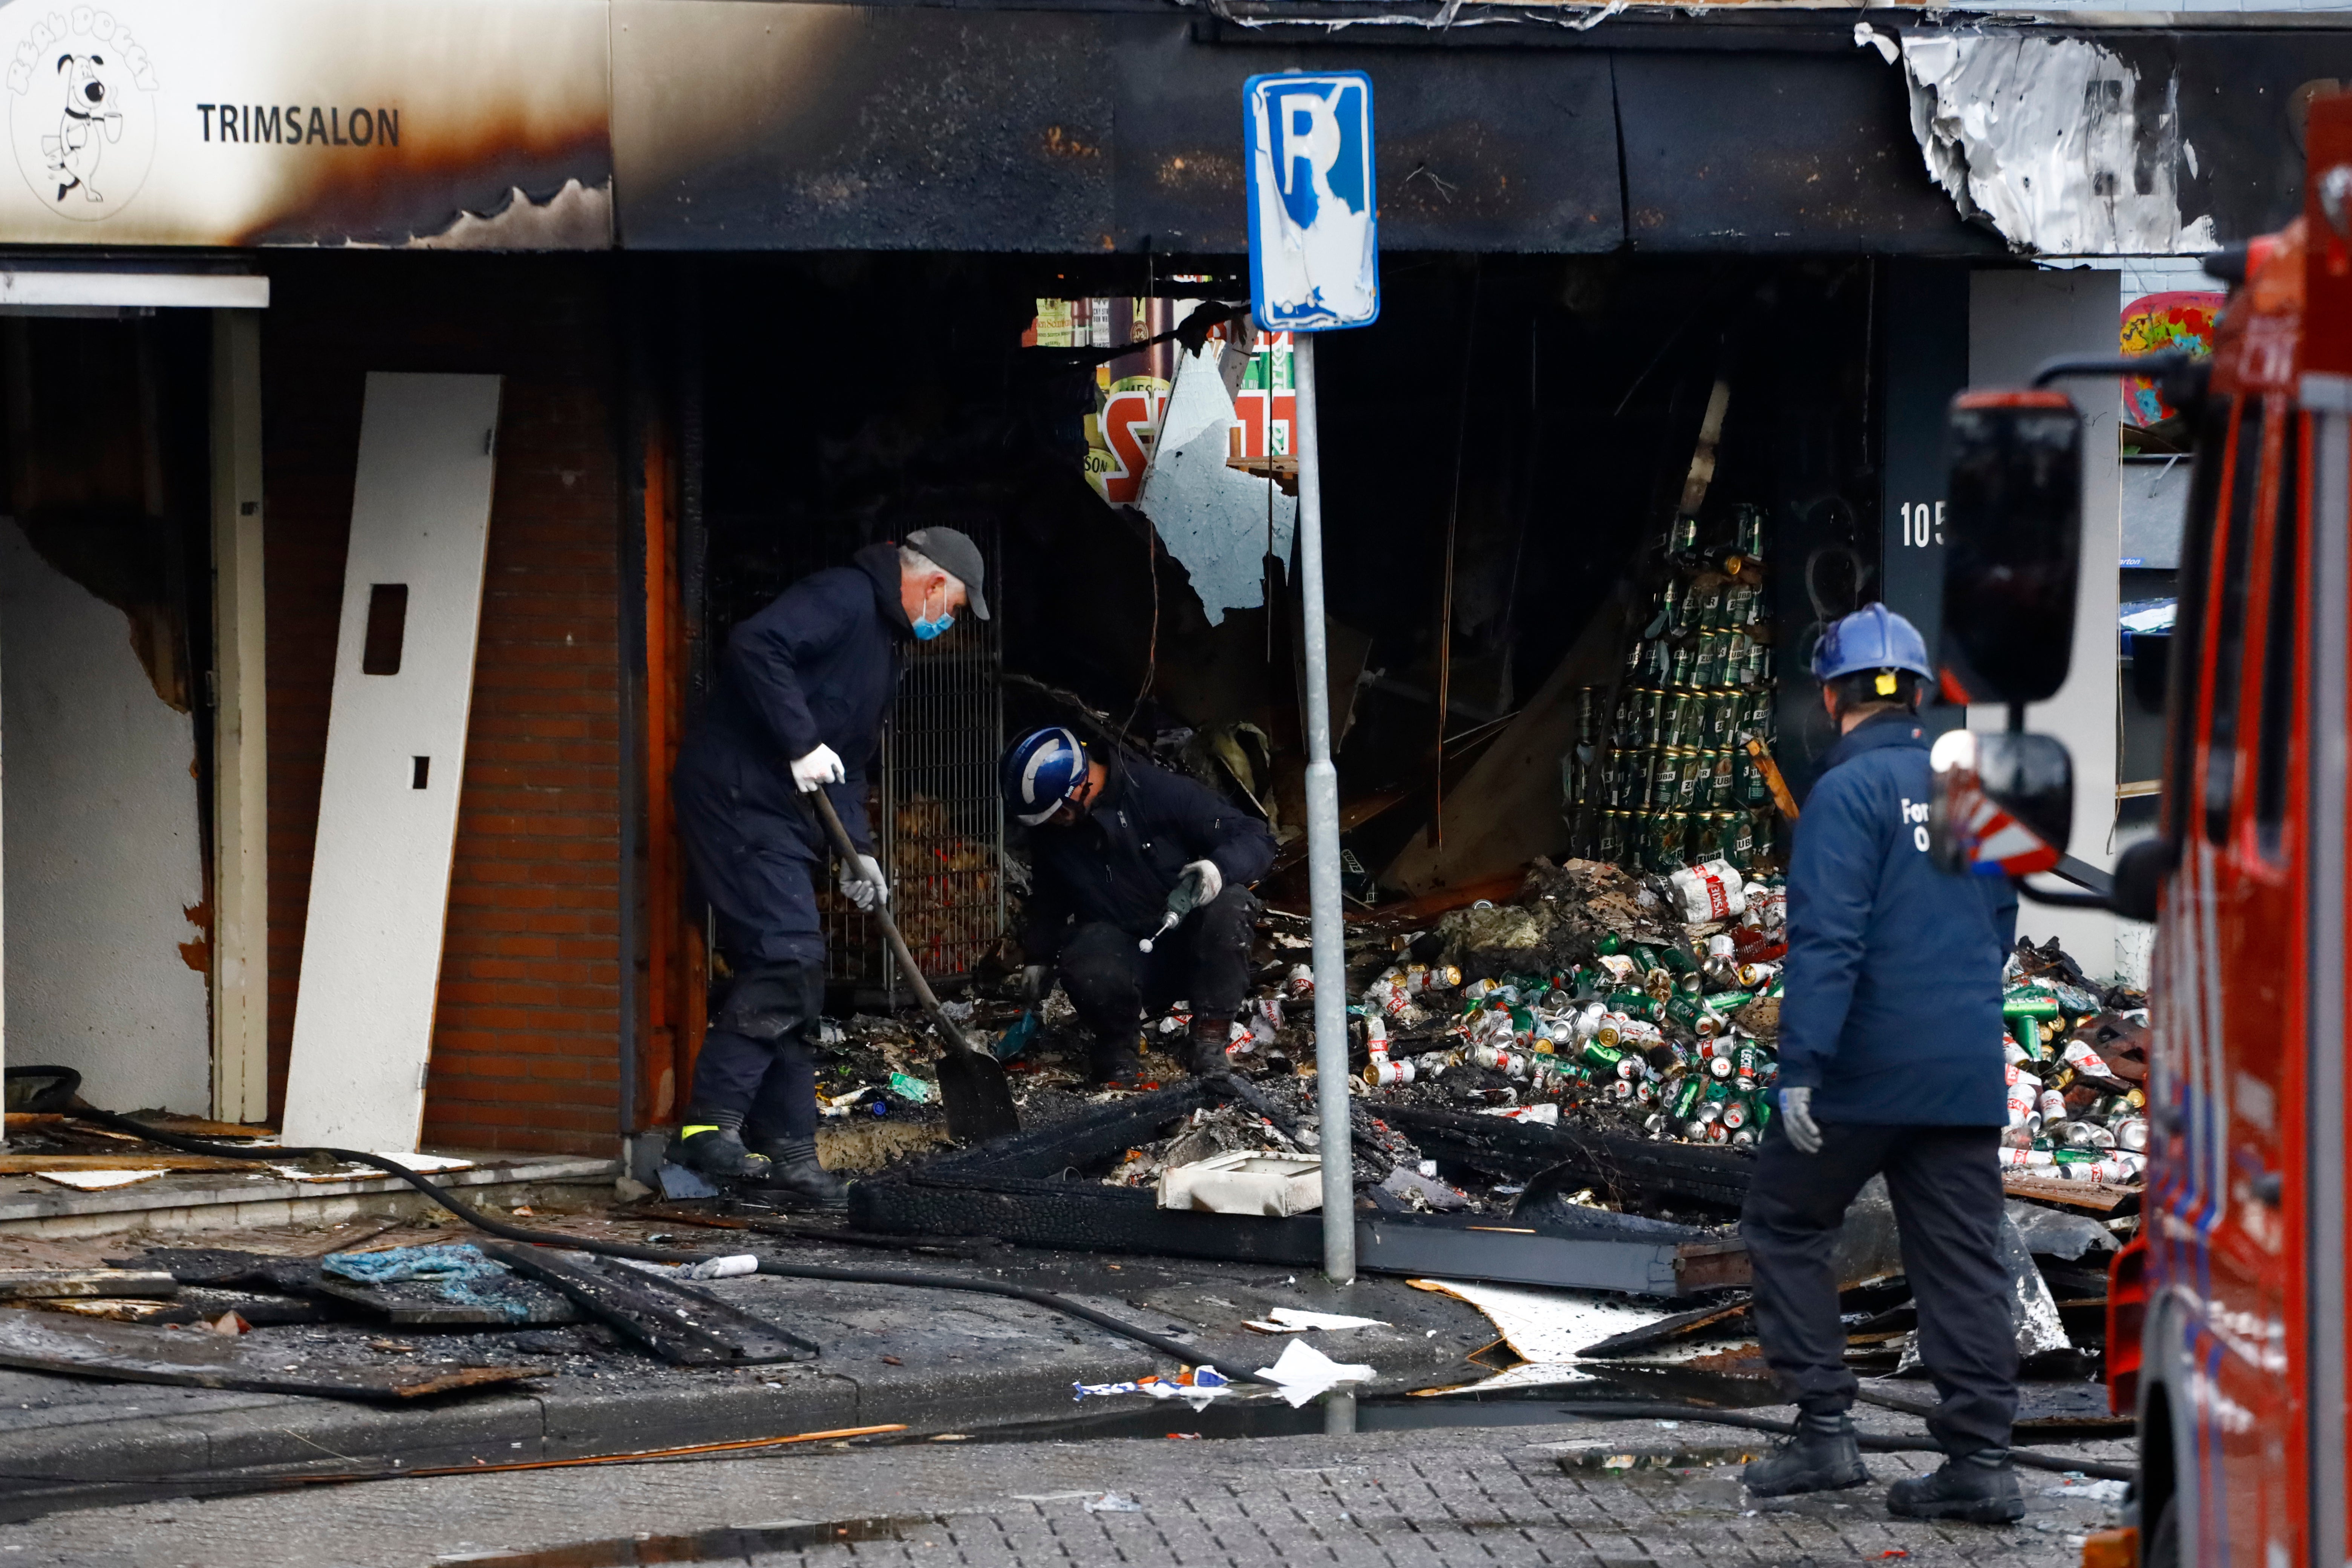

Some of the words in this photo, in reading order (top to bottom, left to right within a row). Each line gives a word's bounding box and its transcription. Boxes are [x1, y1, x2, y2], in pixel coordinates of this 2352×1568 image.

[197, 104, 399, 147] TRIMSALON
[1901, 798, 1931, 824] For
[1741, 1049, 1752, 1069] LECH
